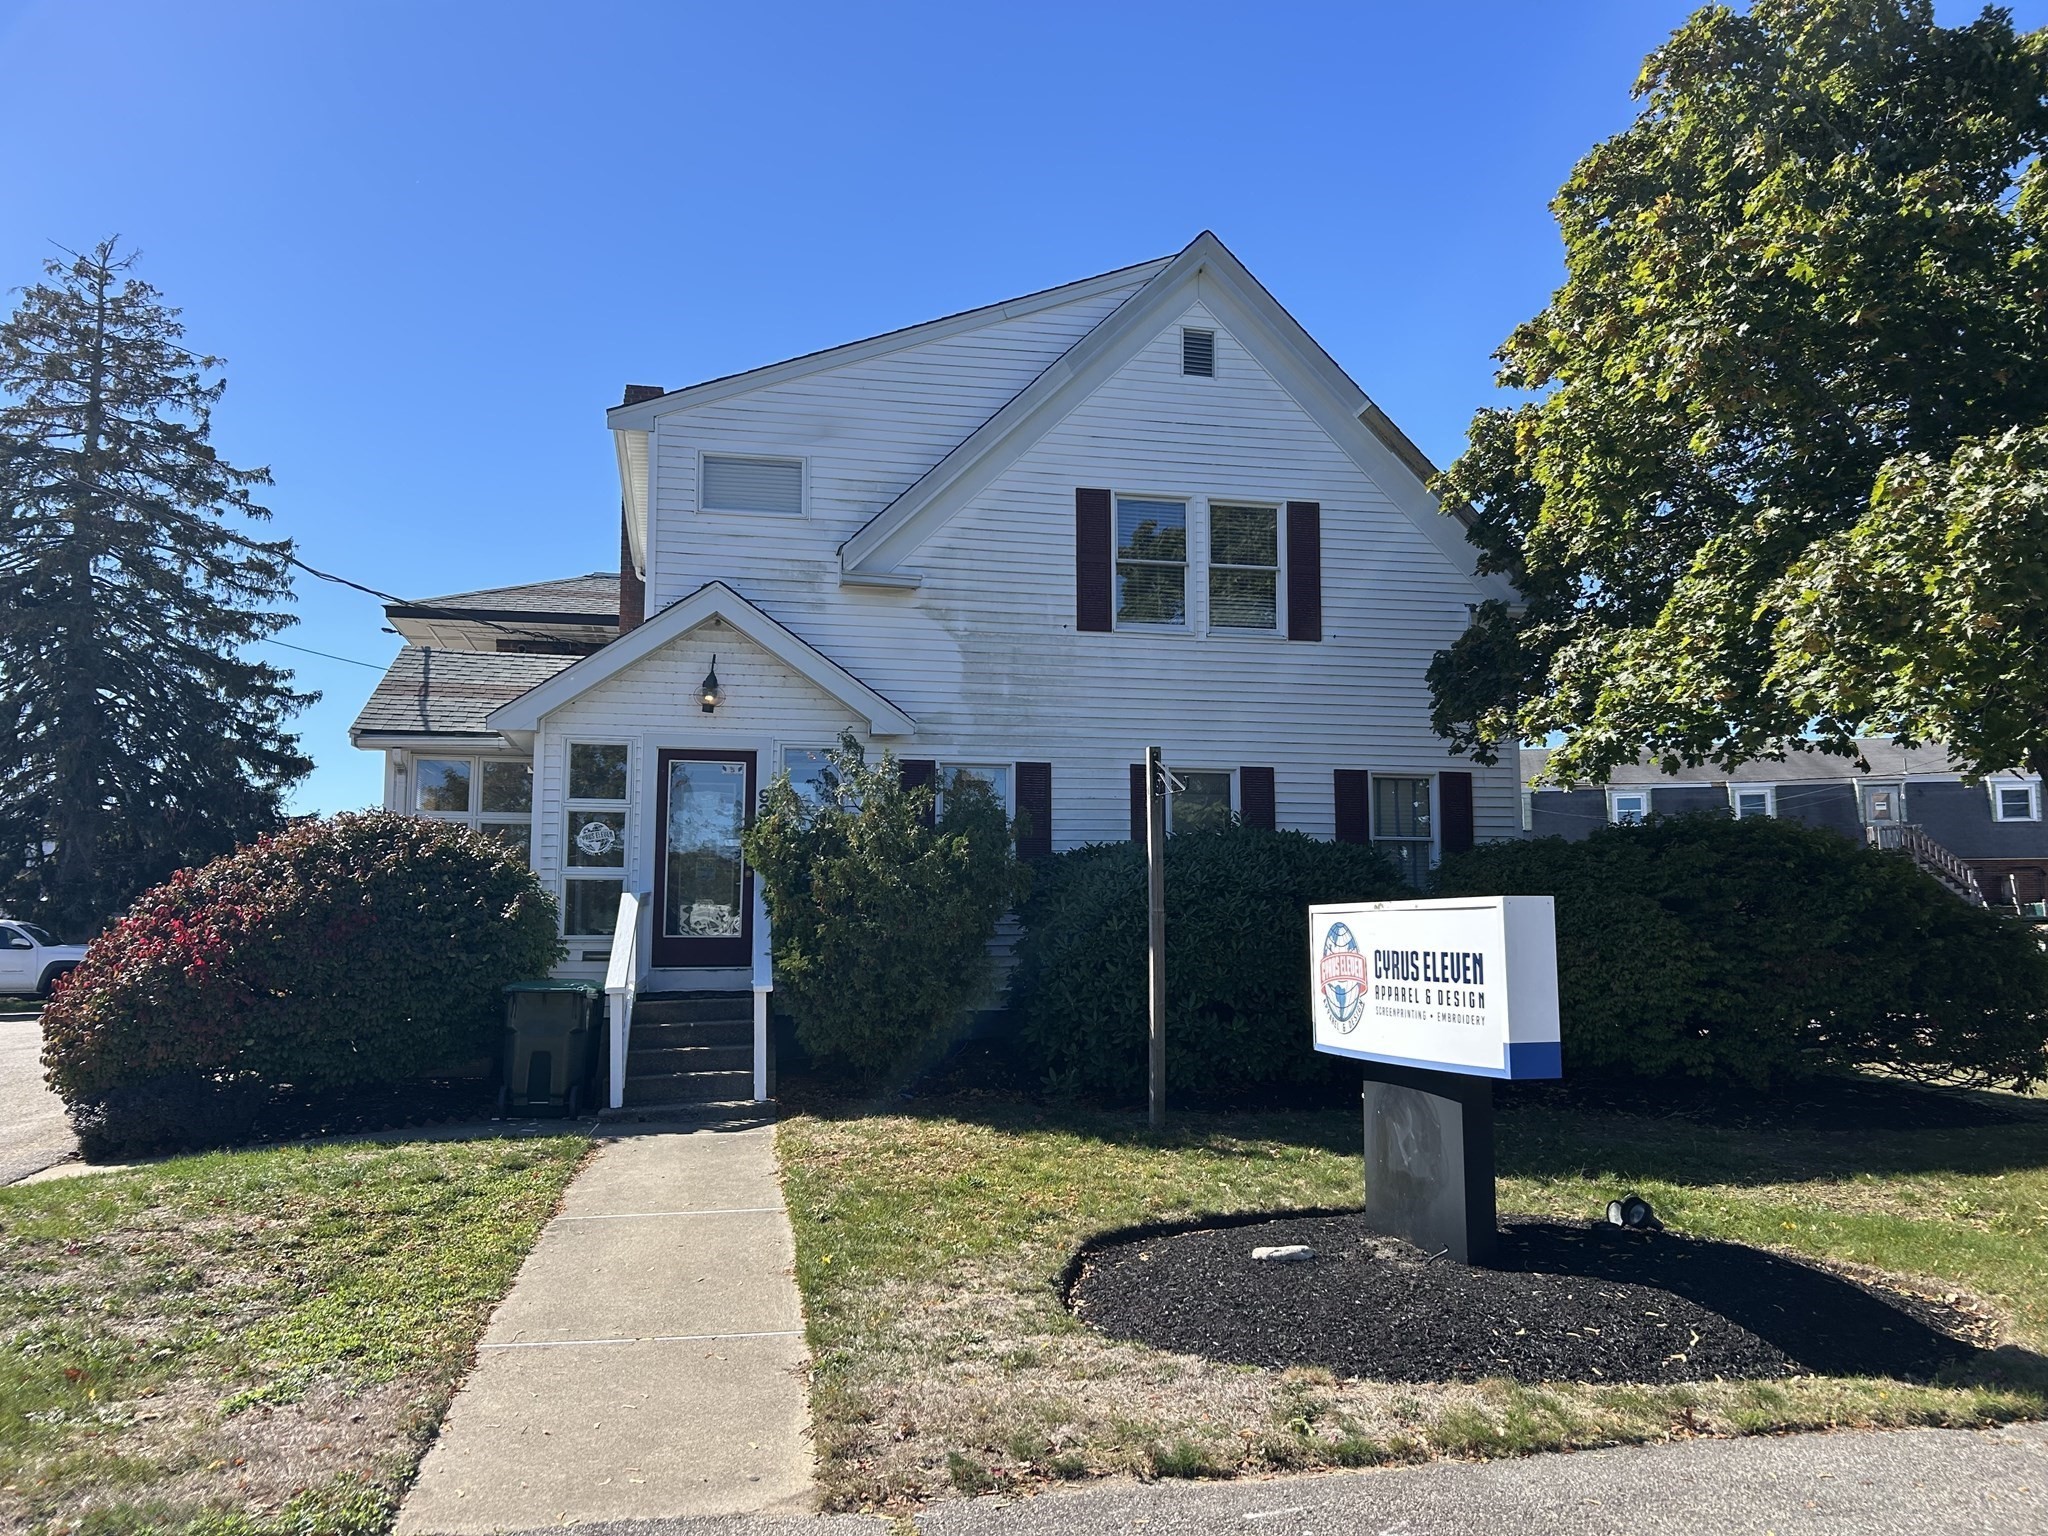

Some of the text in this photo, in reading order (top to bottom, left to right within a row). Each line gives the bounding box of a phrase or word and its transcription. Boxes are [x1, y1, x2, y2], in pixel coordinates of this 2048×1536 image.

[1339, 955, 1363, 980] ELEVEN
[1374, 949, 1484, 985] CYRUS ELEVEN
[1374, 984, 1485, 1009] APPAREL & DESIGN
[1375, 1005, 1486, 1026] SCREENPRINTING EMBROIDERY
